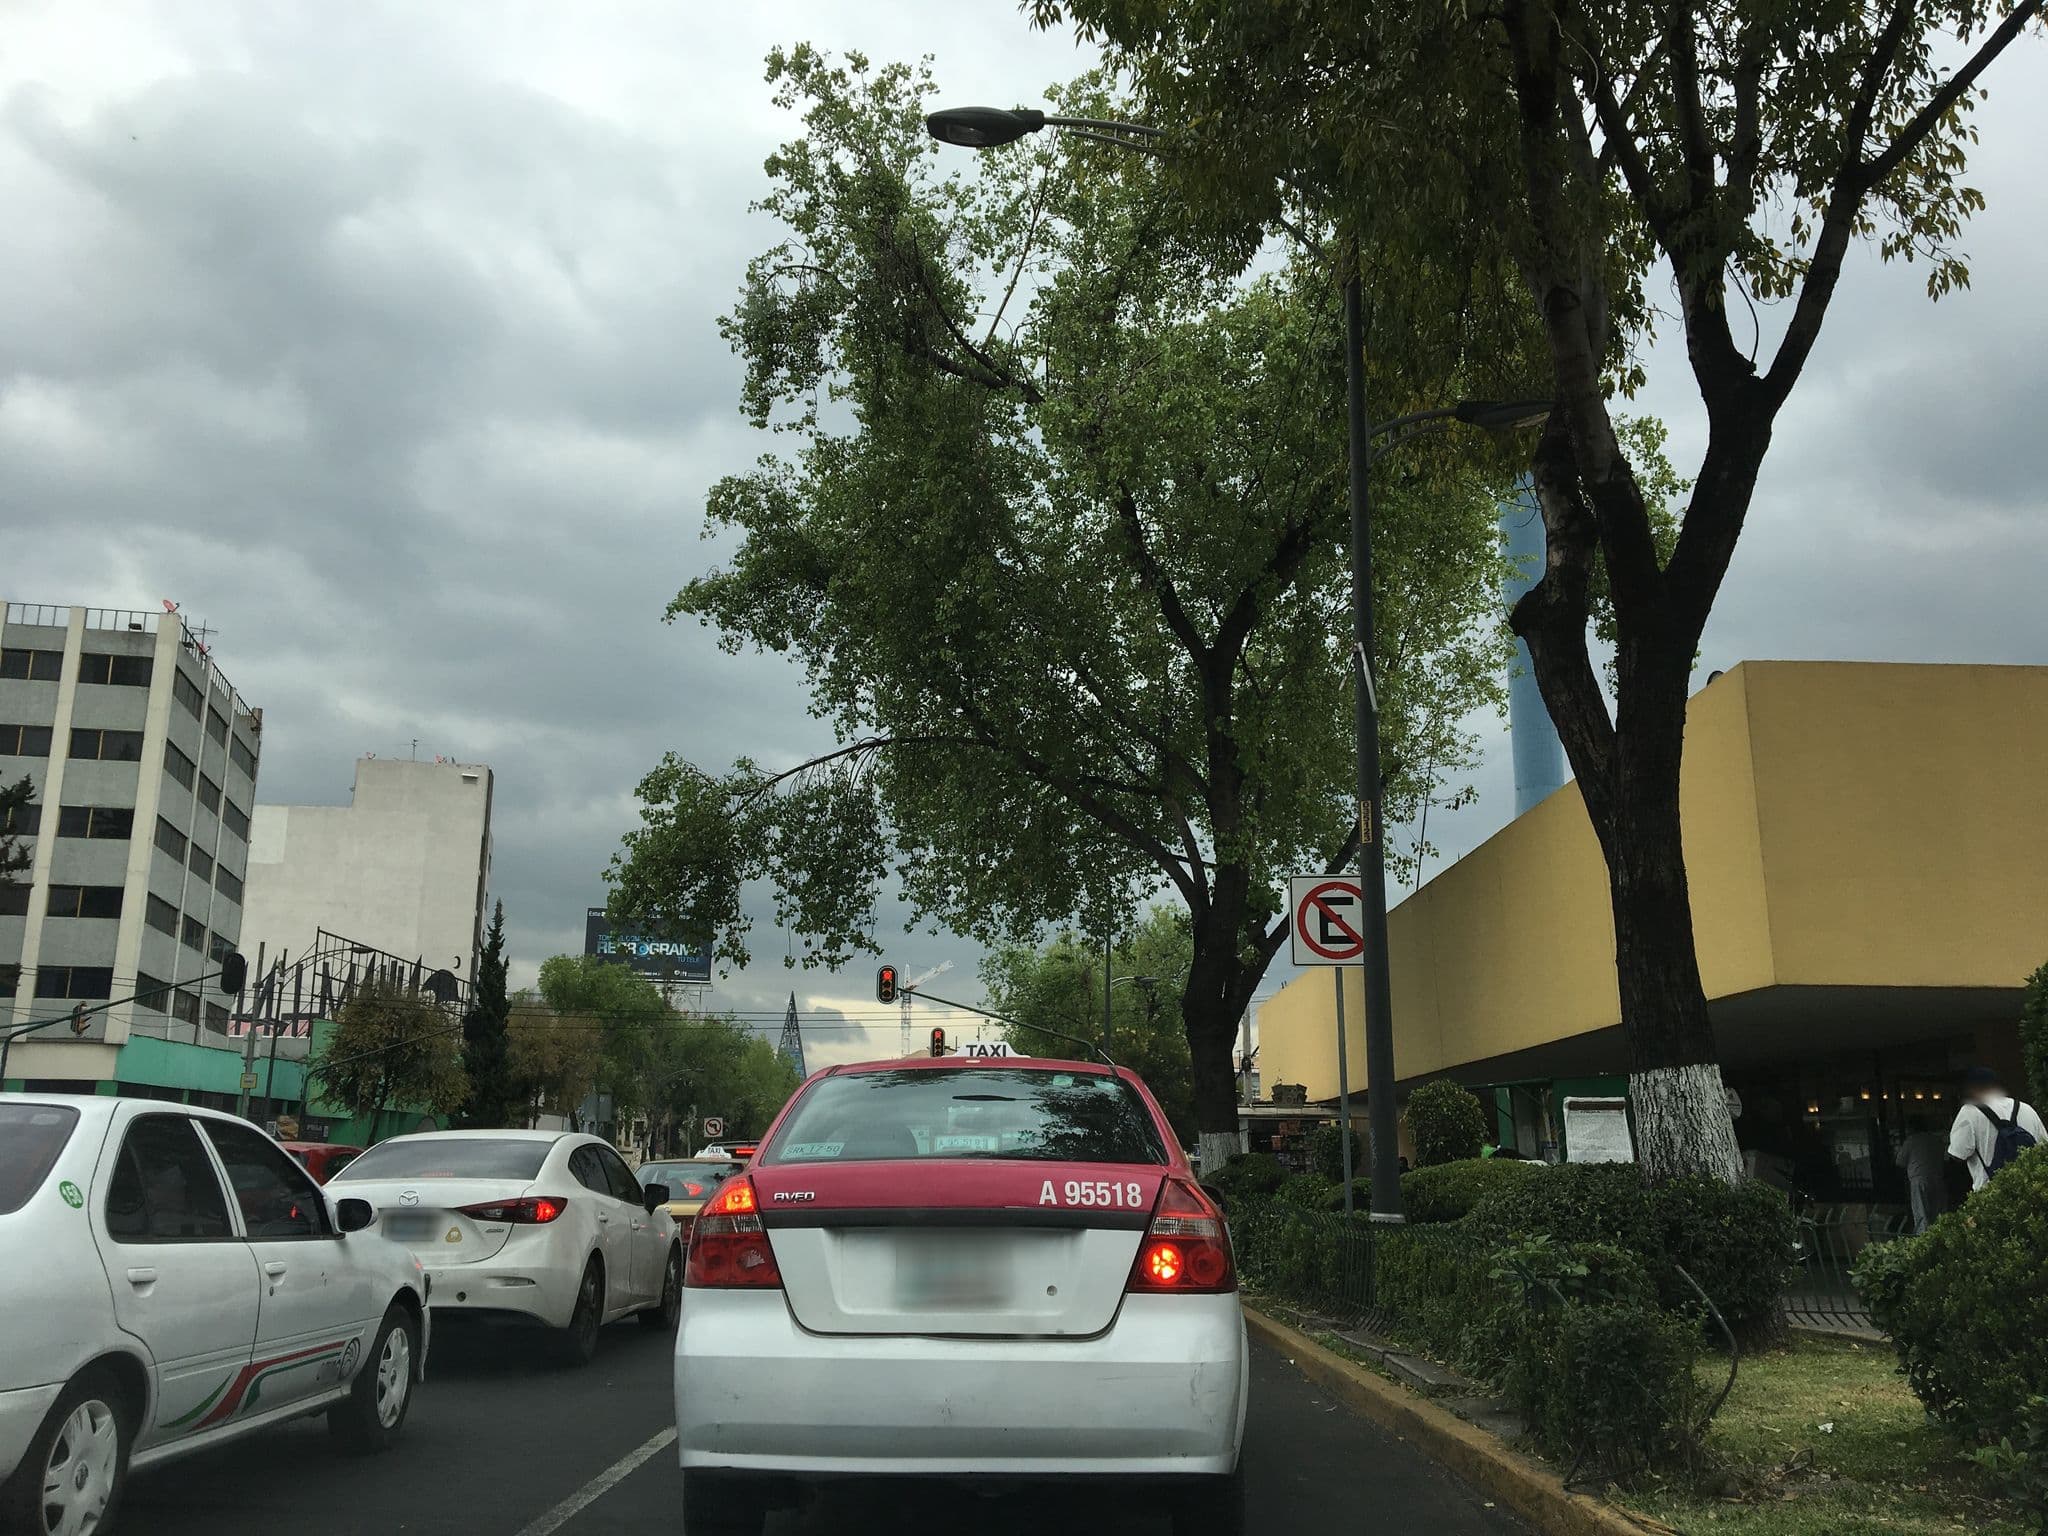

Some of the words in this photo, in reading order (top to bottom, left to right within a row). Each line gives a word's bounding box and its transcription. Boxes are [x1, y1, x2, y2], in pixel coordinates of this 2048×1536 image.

[965, 1044, 1007, 1057] TAXI
[774, 1191, 816, 1201] AVEO
[1039, 1180, 1058, 1205] A
[1064, 1181, 1142, 1208] 95518
